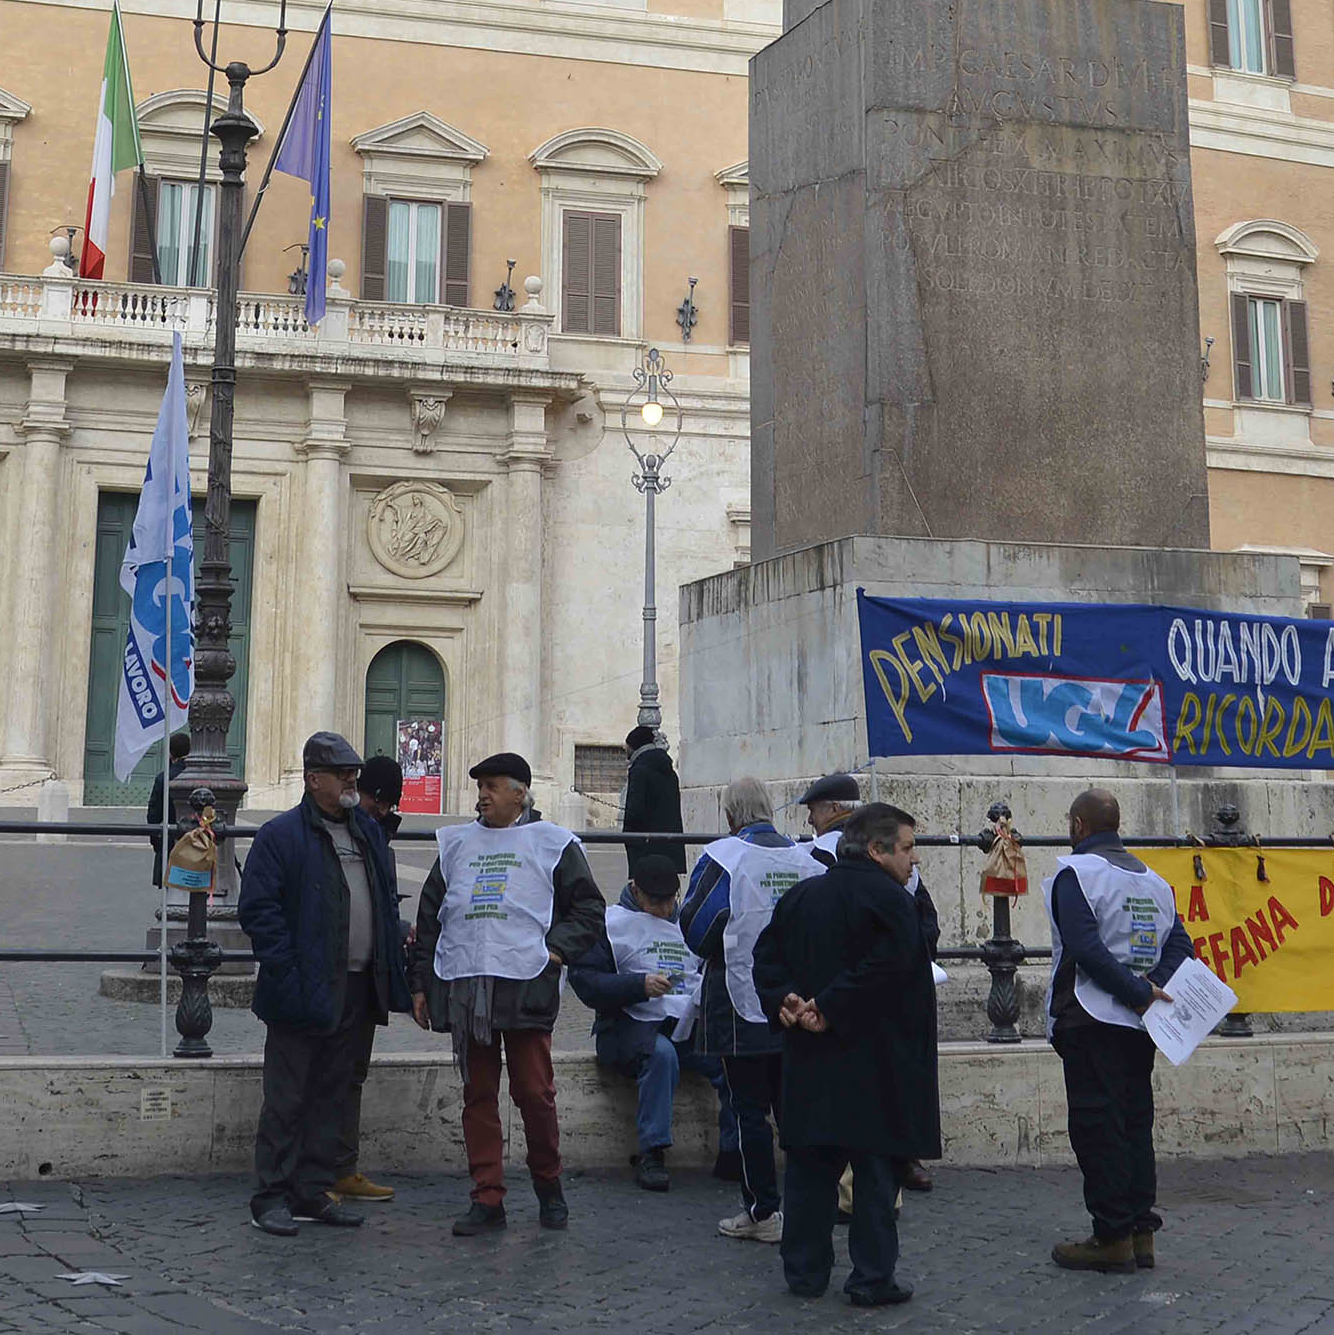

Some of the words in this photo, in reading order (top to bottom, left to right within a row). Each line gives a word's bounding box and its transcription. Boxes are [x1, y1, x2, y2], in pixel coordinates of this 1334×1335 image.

[123, 641, 158, 721] LAVORO
[870, 612, 1062, 743] PENSIONATI
[1169, 618, 1302, 685] QUANDO
[991, 677, 1161, 753] UGL
